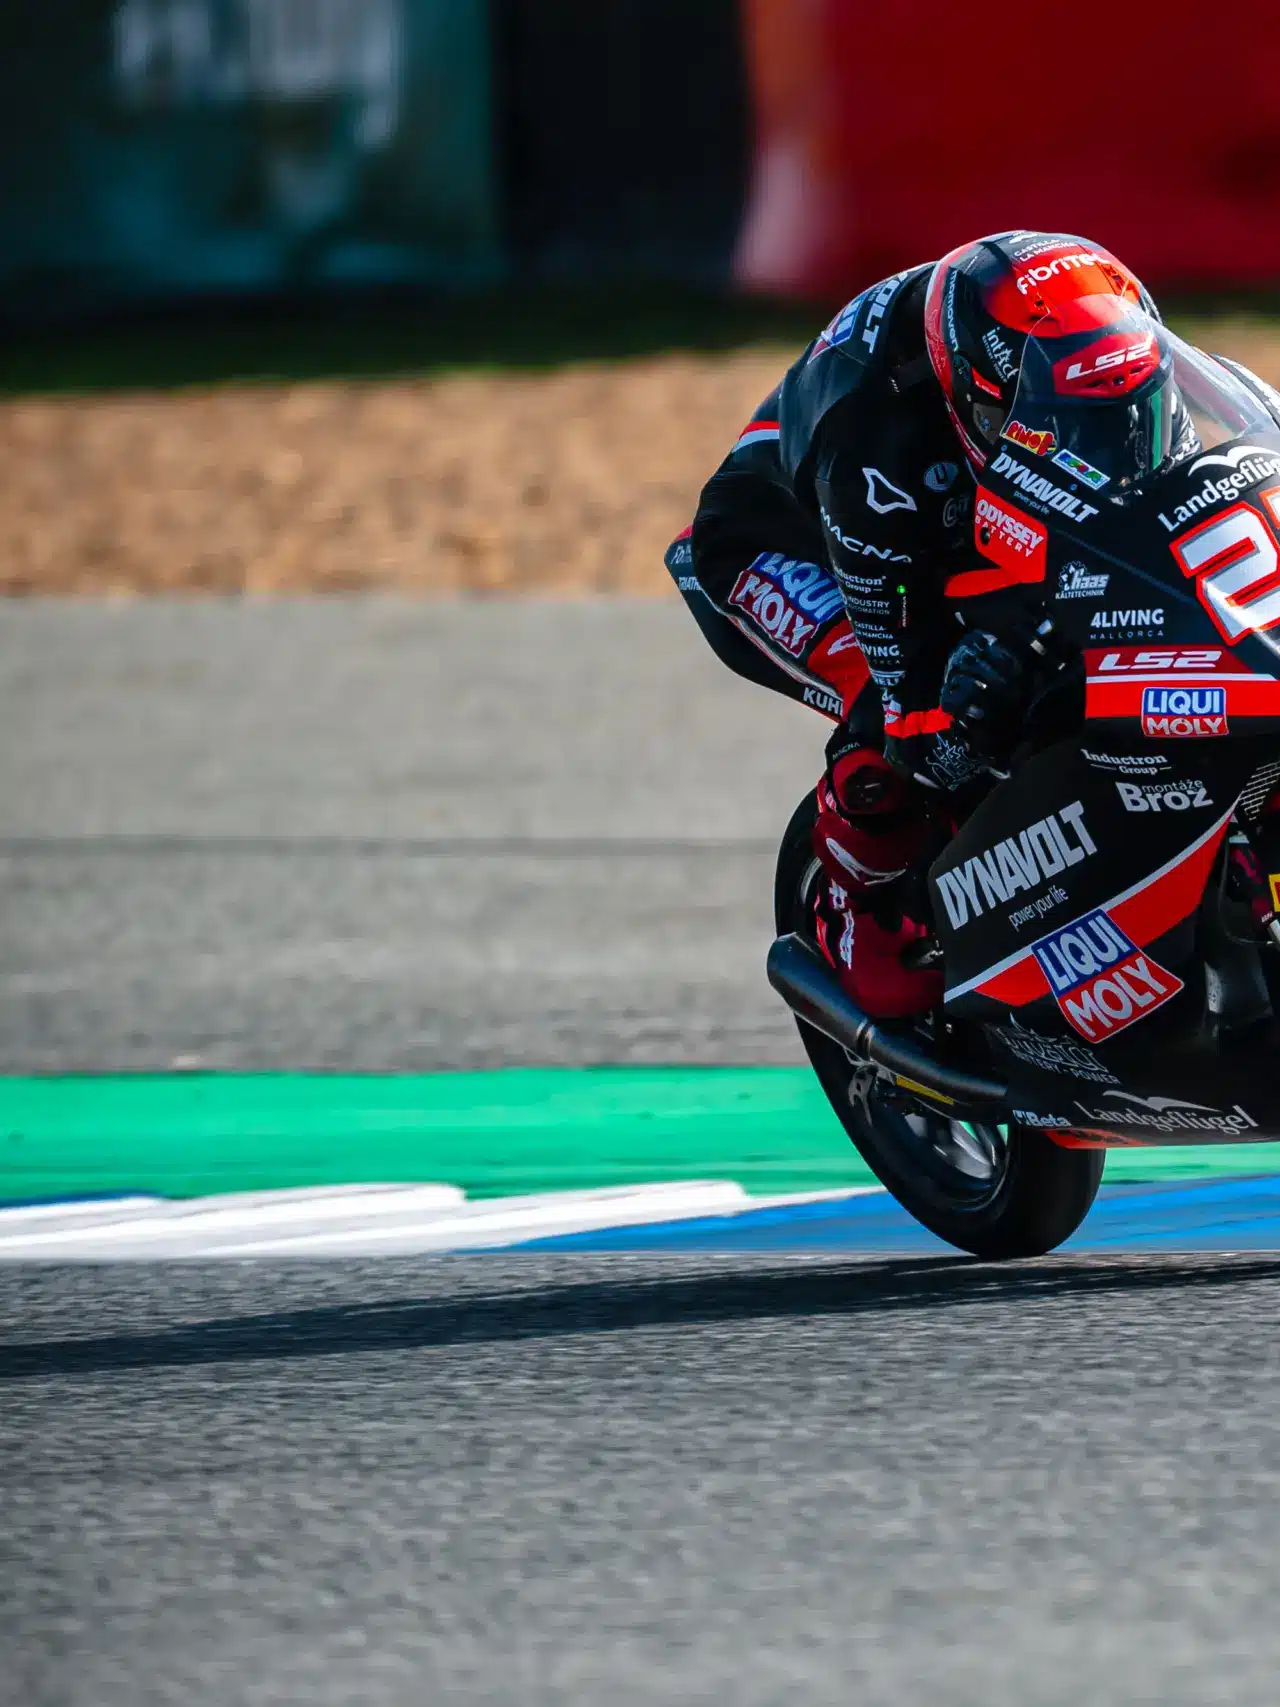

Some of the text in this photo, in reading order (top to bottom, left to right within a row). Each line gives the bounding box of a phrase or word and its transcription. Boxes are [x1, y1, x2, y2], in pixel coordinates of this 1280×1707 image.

[1065, 339, 1153, 381] LS2
[990, 452, 1099, 523] DYNAVOLT
[975, 515, 1034, 558] BATTERY
[977, 499, 1044, 550] ODYSSEY
[761, 552, 844, 619] LIQUI
[735, 574, 815, 649] MOLY
[1090, 608, 1165, 629] 4LIVING
[1090, 630, 1164, 640] MALLORCA
[1098, 650, 1222, 671] LS2
[1147, 690, 1221, 716] LIQUI
[1146, 717, 1224, 736] MOLY
[1080, 748, 1168, 765] Inductron
[1119, 765, 1158, 775] Group
[935, 800, 1098, 931] DYNAVOLT
[1008, 884, 1069, 932] power your life
[1037, 915, 1131, 991] LIQUI
[1065, 956, 1168, 1038] MOLY
[1026, 1110, 1073, 1127] Beta
[1073, 1100, 1260, 1135] Landgeflügel
